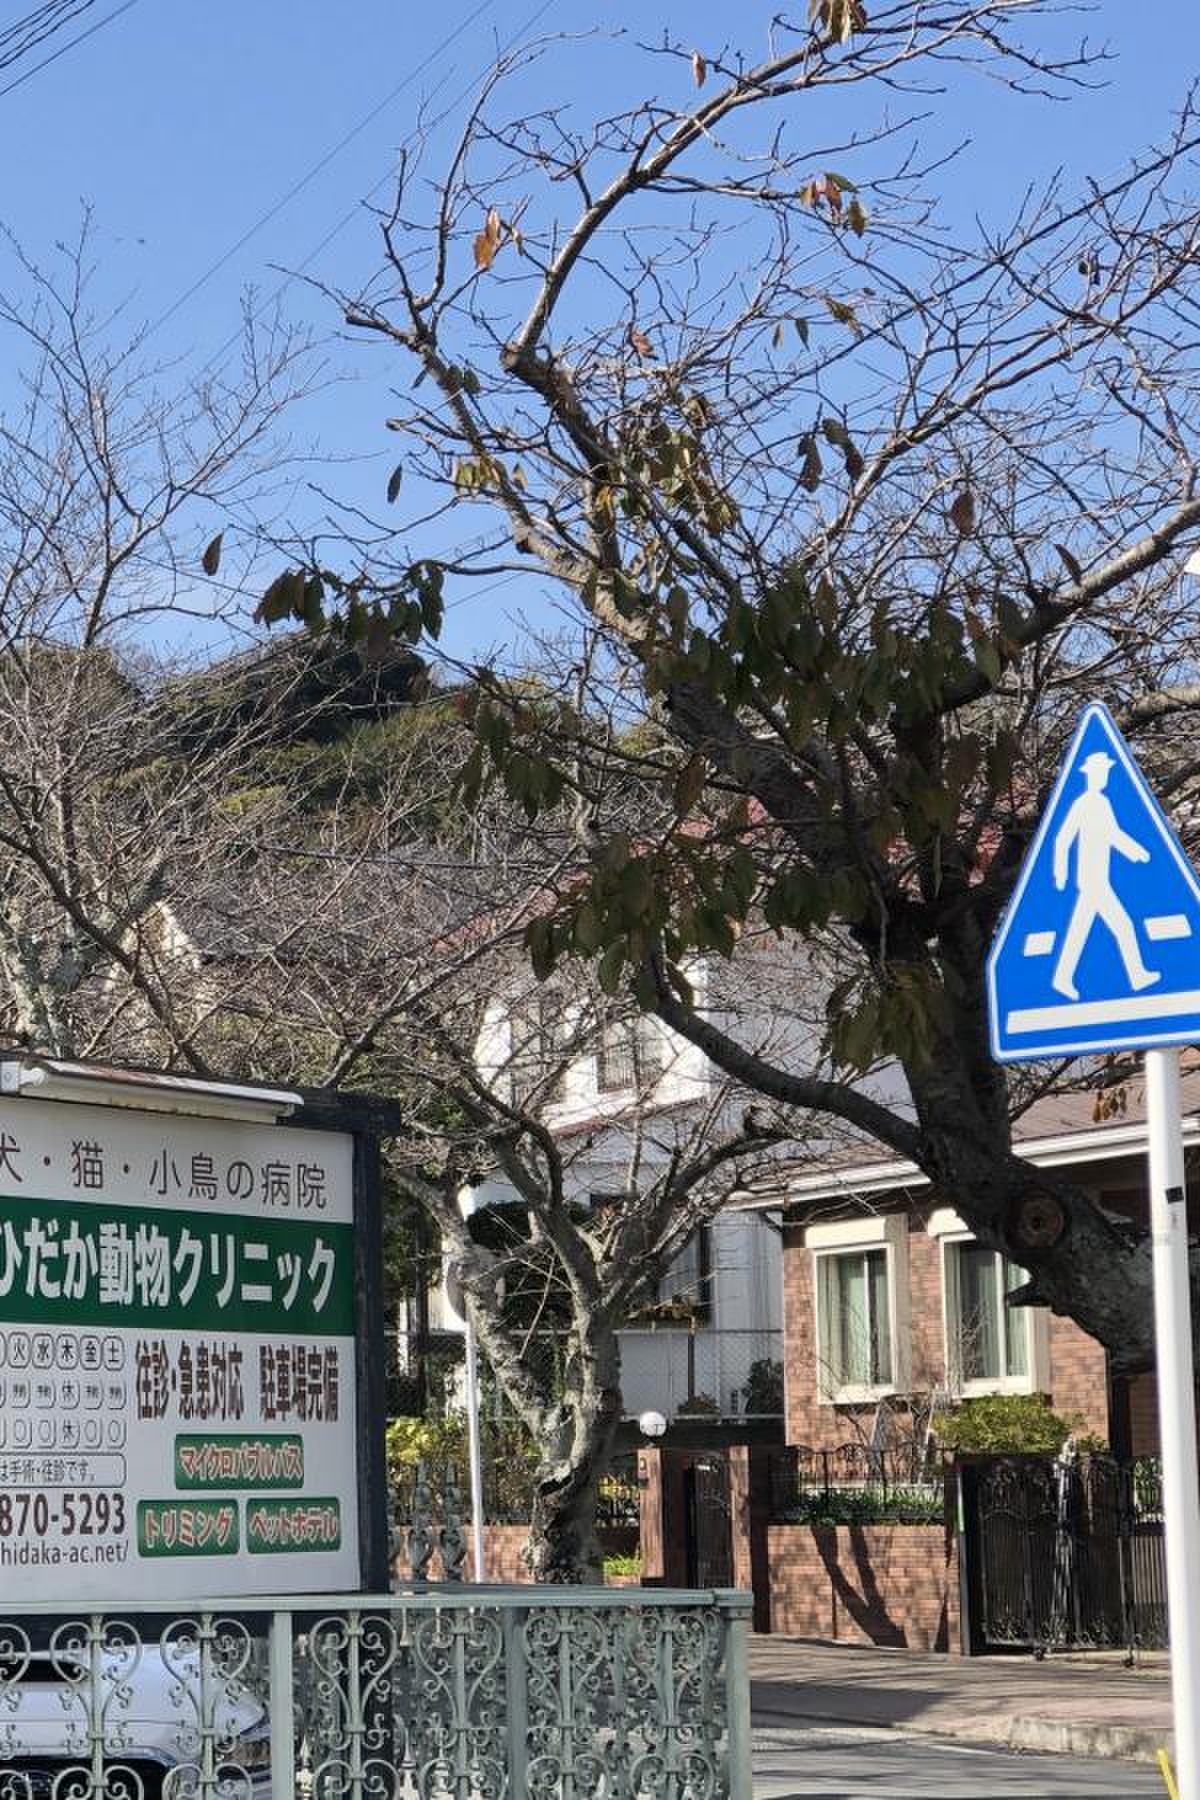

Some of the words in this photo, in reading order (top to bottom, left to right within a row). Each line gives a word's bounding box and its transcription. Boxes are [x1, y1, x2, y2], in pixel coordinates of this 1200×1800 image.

[14, 1338, 26, 1361] 火
[37, 1339, 50, 1361] 水
[62, 1339, 74, 1362] 木
[85, 1340, 97, 1363] 金
[108, 1341, 120, 1363] 土
[144, 1506, 235, 1548] トリミング
[249, 1506, 337, 1545] ペットホテル
